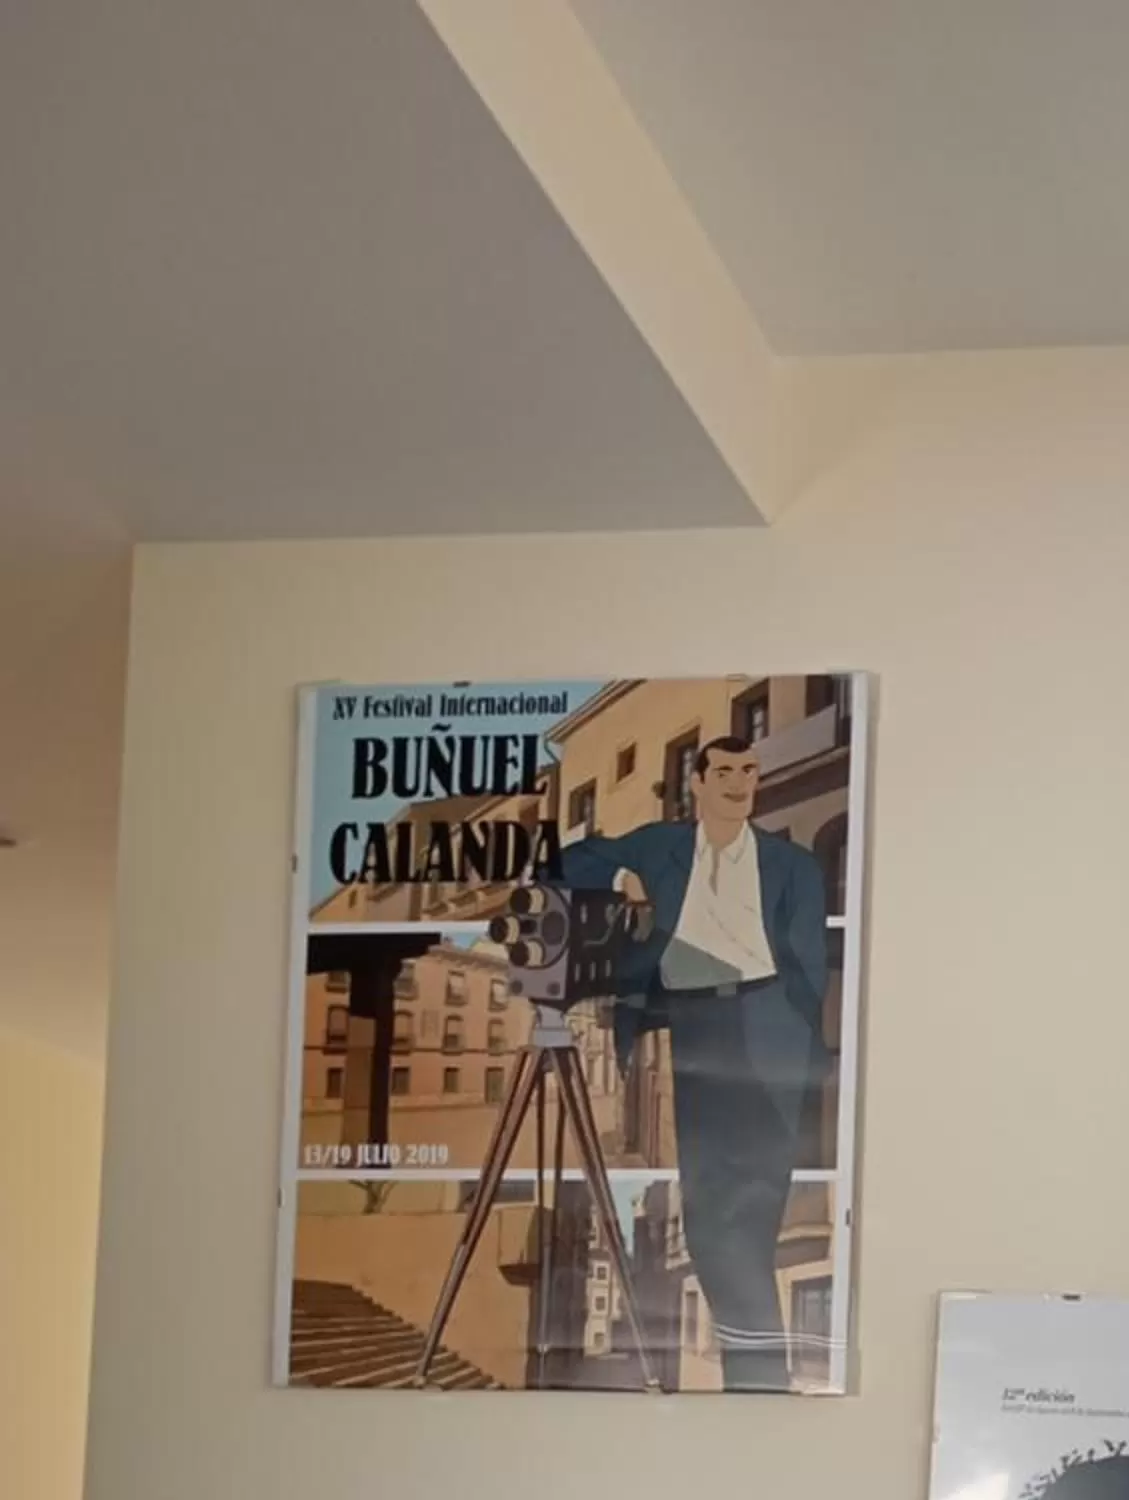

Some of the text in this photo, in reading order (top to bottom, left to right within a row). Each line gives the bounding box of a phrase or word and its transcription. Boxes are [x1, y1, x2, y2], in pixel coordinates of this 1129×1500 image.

[333, 691, 568, 720] XV Festival Internacional
[352, 723, 547, 798] BUÑUEL
[329, 821, 564, 885] CALANDA
[304, 1142, 449, 1167] 13/19 JULIO 2019
